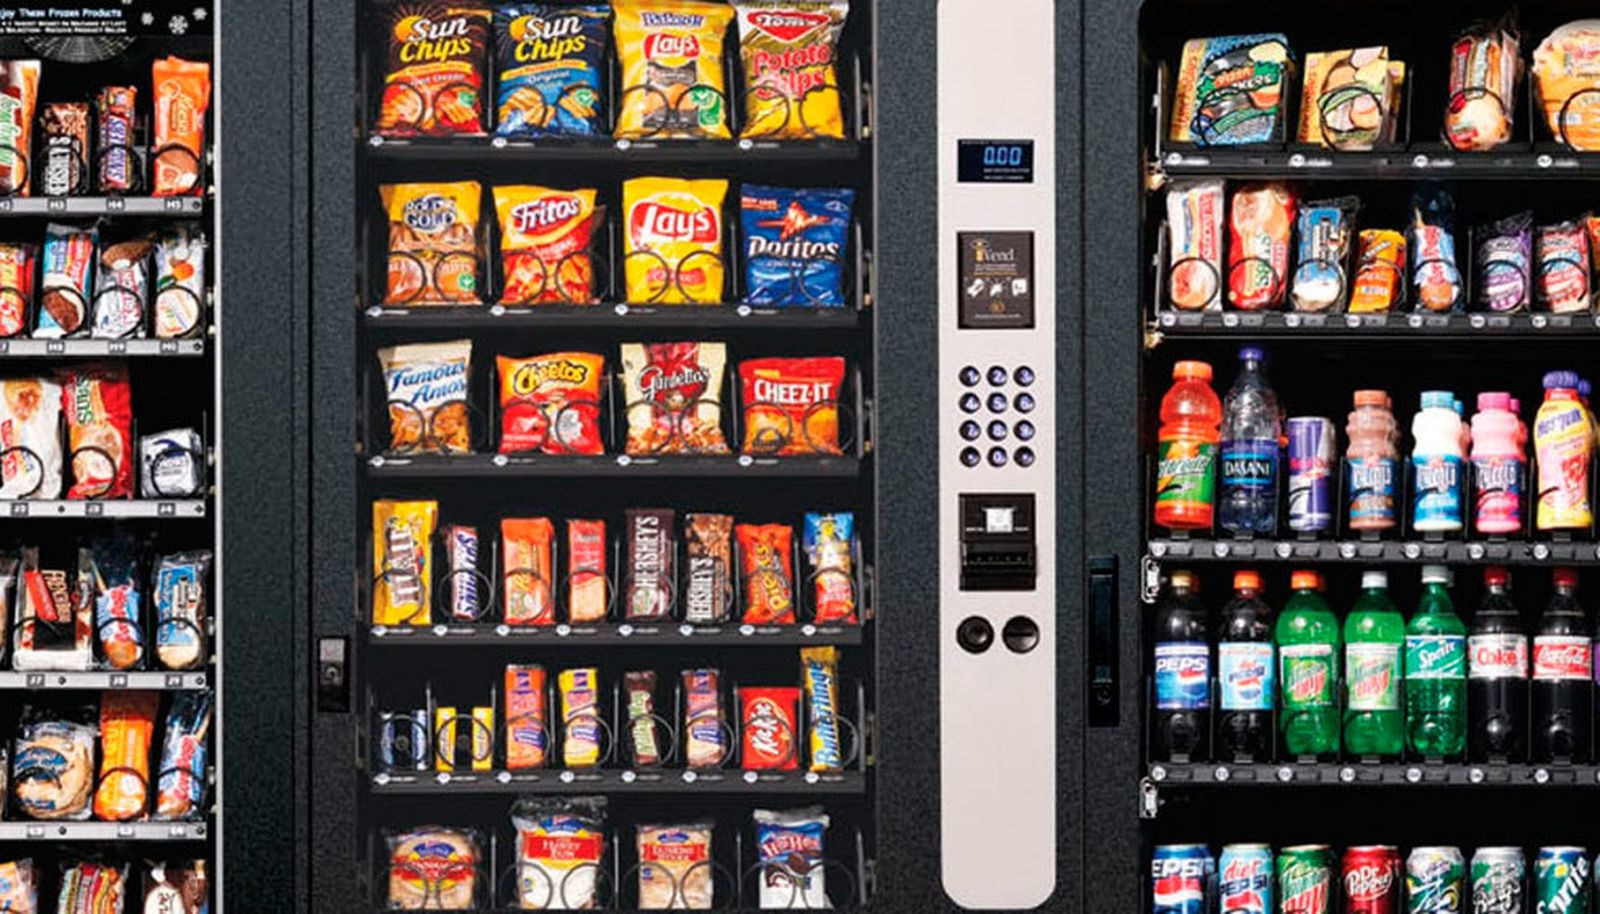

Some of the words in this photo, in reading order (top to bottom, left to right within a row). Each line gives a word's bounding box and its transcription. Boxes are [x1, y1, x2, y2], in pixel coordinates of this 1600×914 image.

[19, 7, 45, 17] These
[48, 7, 80, 18] Frozen
[82, 7, 122, 18] Products
[408, 17, 469, 42] Sun
[523, 15, 583, 41] Sun
[400, 37, 472, 62] Chips
[514, 35, 587, 61] Chips
[753, 43, 832, 75] Potato
[405, 211, 455, 229] GOLD
[511, 197, 579, 234] Fritos
[639, 204, 711, 244] Lay's
[748, 235, 839, 261] Doritos
[388, 361, 466, 392] Famous
[514, 360, 589, 396] Cheetos
[410, 378, 466, 405] Amos
[1224, 460, 1270, 477] DASANI
[634, 516, 659, 588] HERSHEY'S
[1156, 657, 1206, 673] PEPS
[1419, 642, 1456, 669] Sprite
[1477, 648, 1518, 667] Coke
[1152, 859, 1204, 878] EPSI
